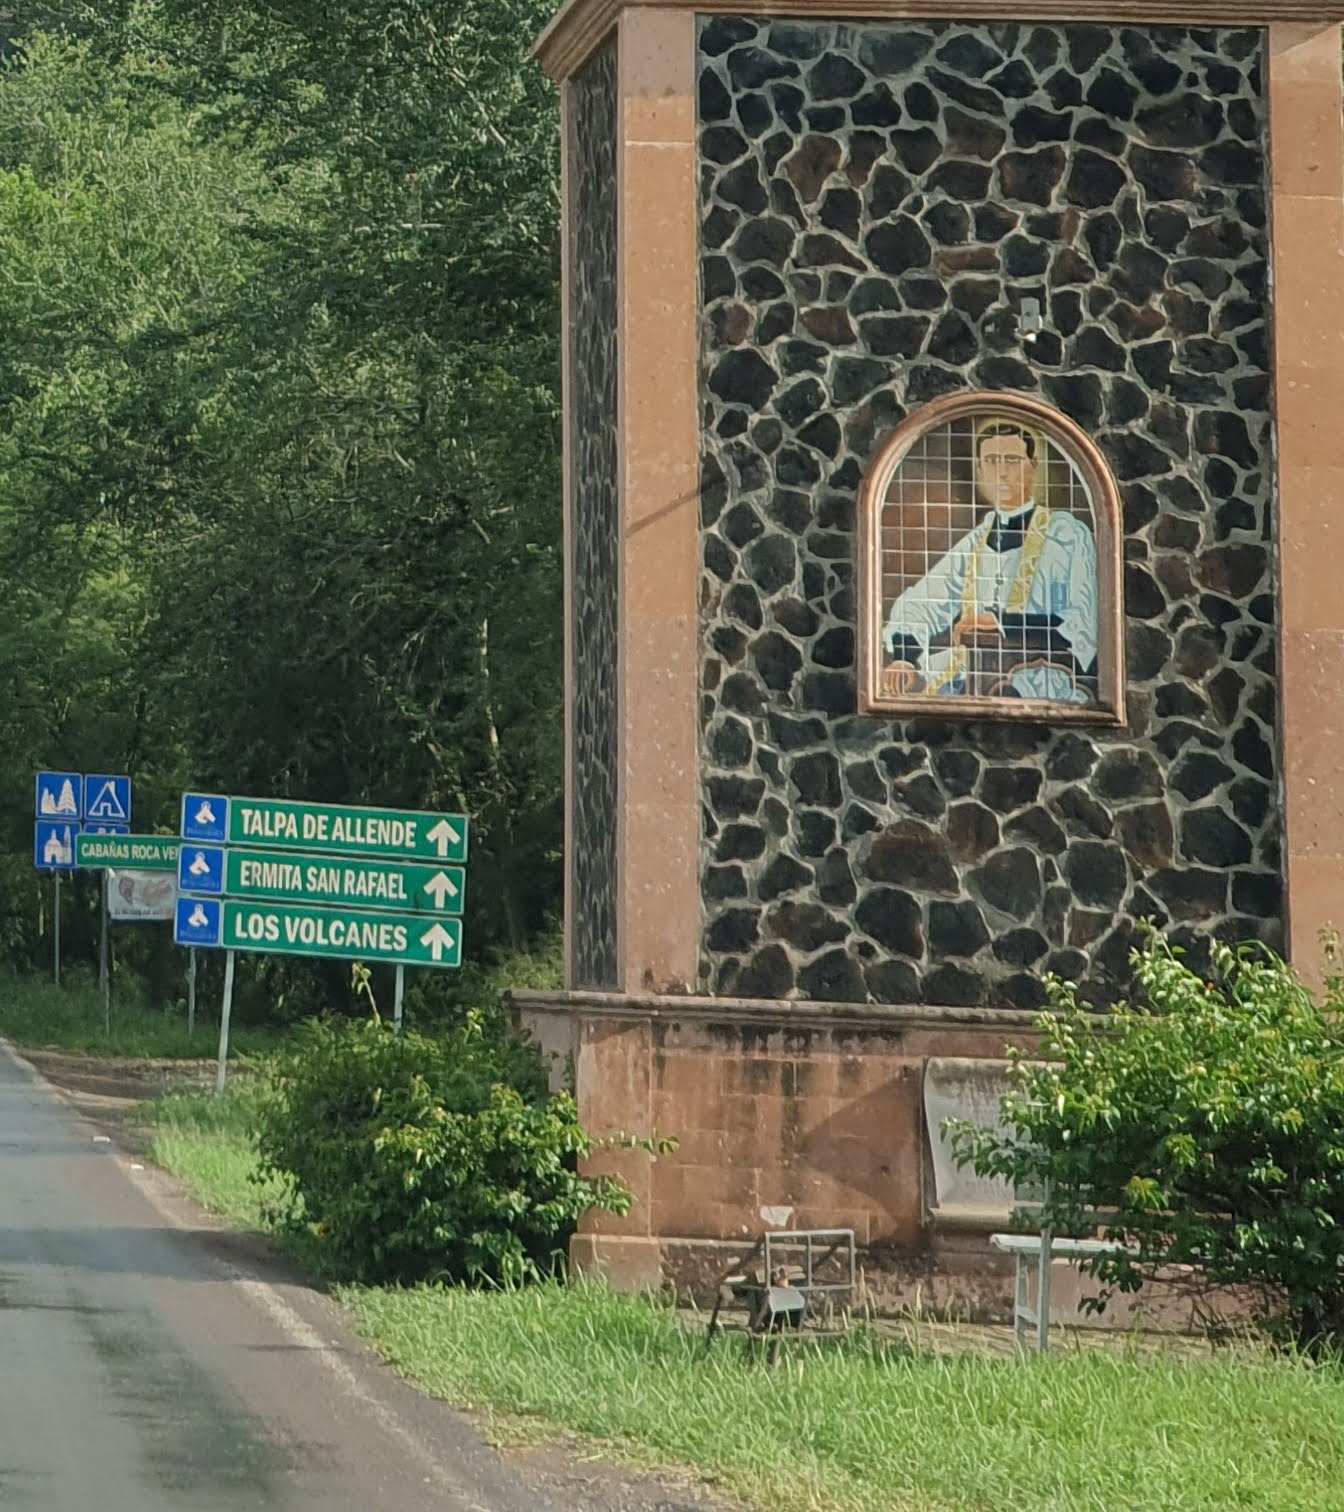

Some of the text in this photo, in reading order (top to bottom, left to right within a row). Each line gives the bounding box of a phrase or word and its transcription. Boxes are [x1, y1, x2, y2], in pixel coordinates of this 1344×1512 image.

[240, 808, 417, 849] TALPA DE ALLENDE
[81, 841, 130, 858] CABAÑAS
[131, 845, 161, 860] ROCA
[240, 860, 408, 900] ERMITA SAN RAFAEL
[235, 912, 408, 952] LOS VOLCANES
